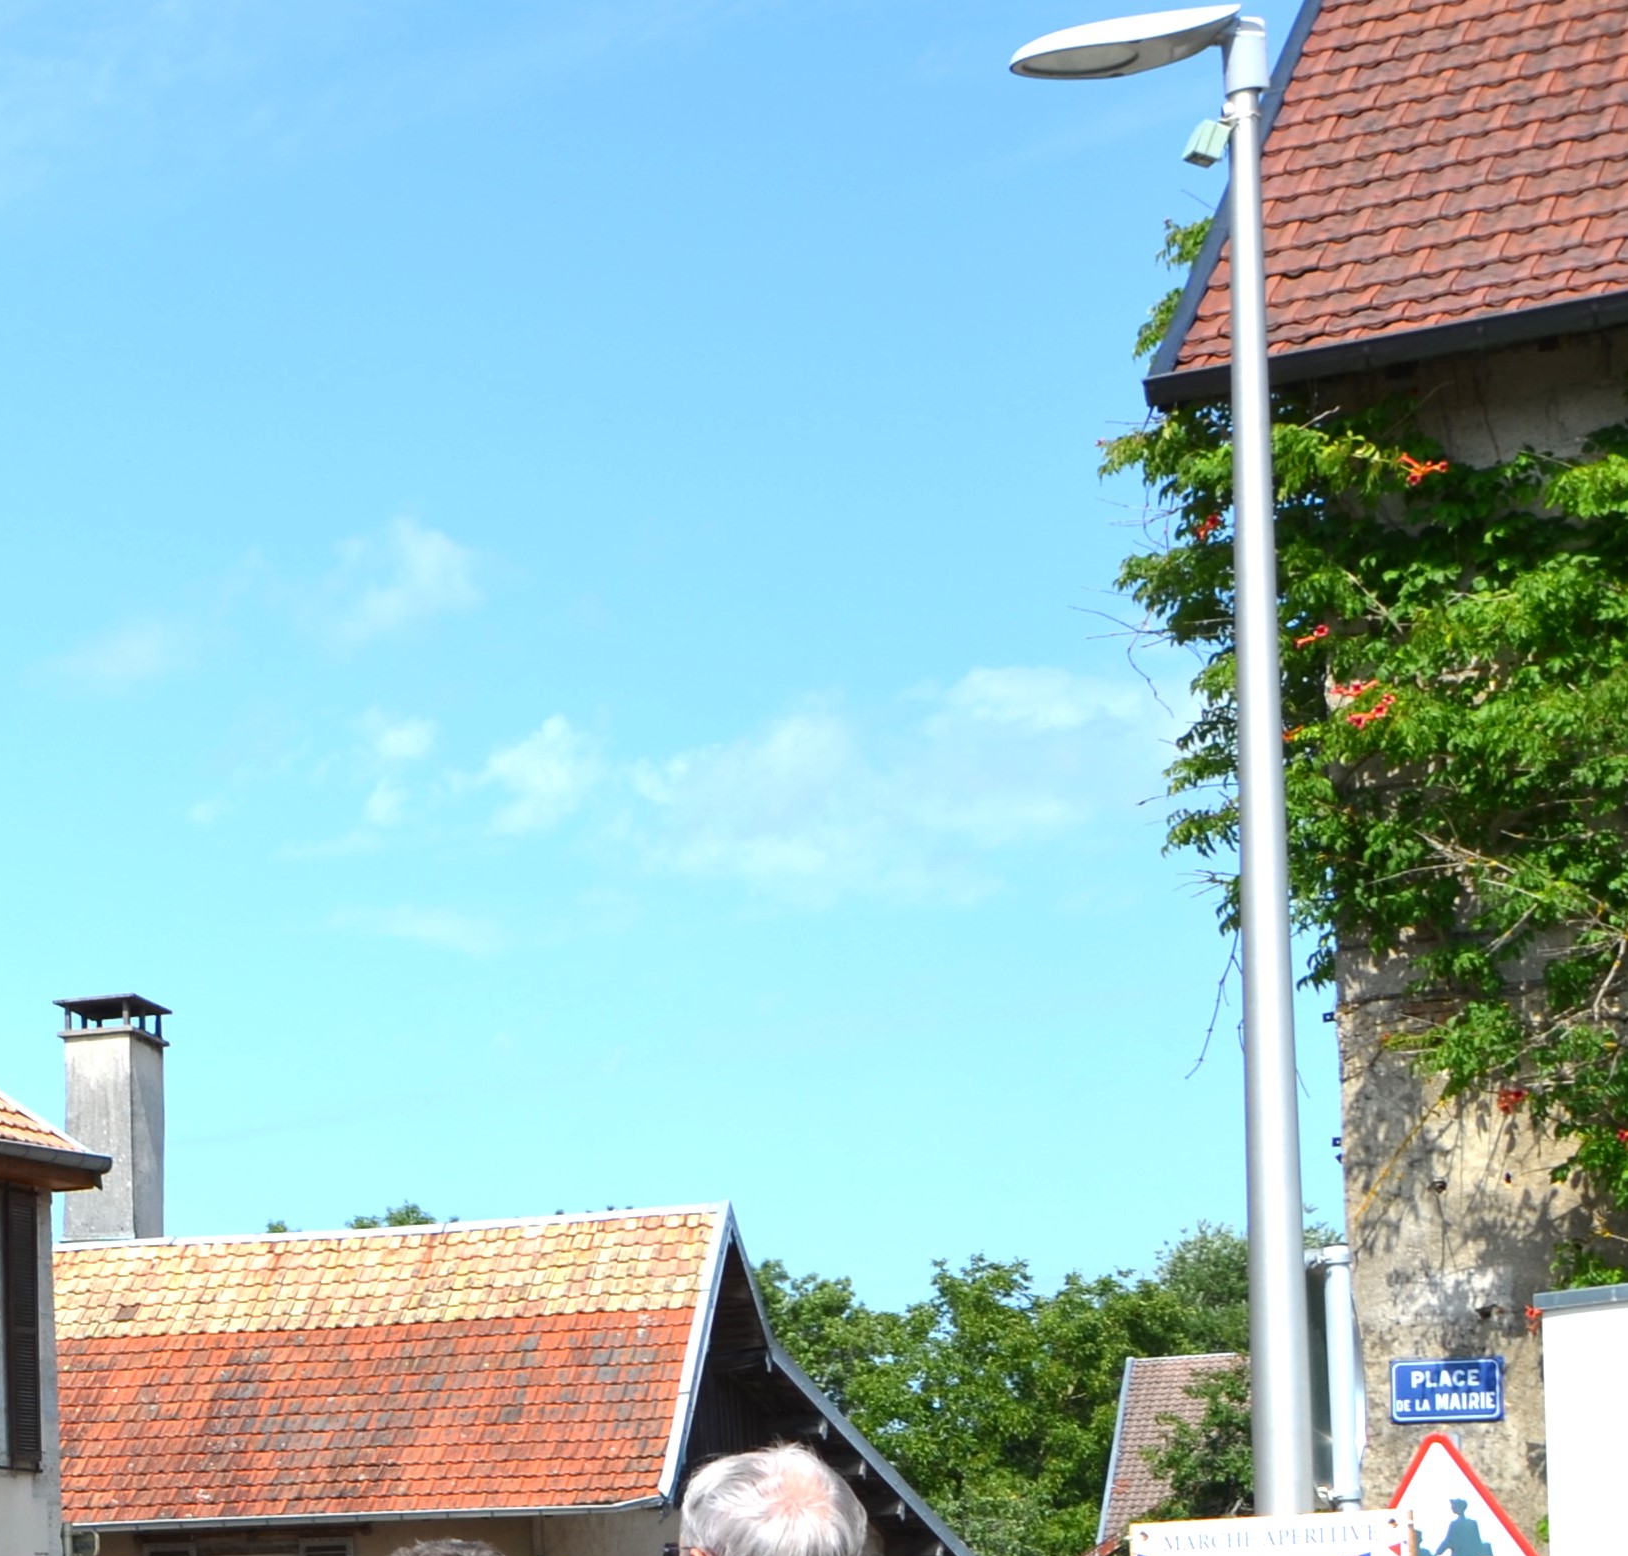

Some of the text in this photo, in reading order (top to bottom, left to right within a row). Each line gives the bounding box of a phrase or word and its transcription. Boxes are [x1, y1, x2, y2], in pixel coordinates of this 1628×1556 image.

[1411, 1369, 1480, 1388] PLACE
[1396, 1392, 1496, 1412] DE LA MAIRIE
